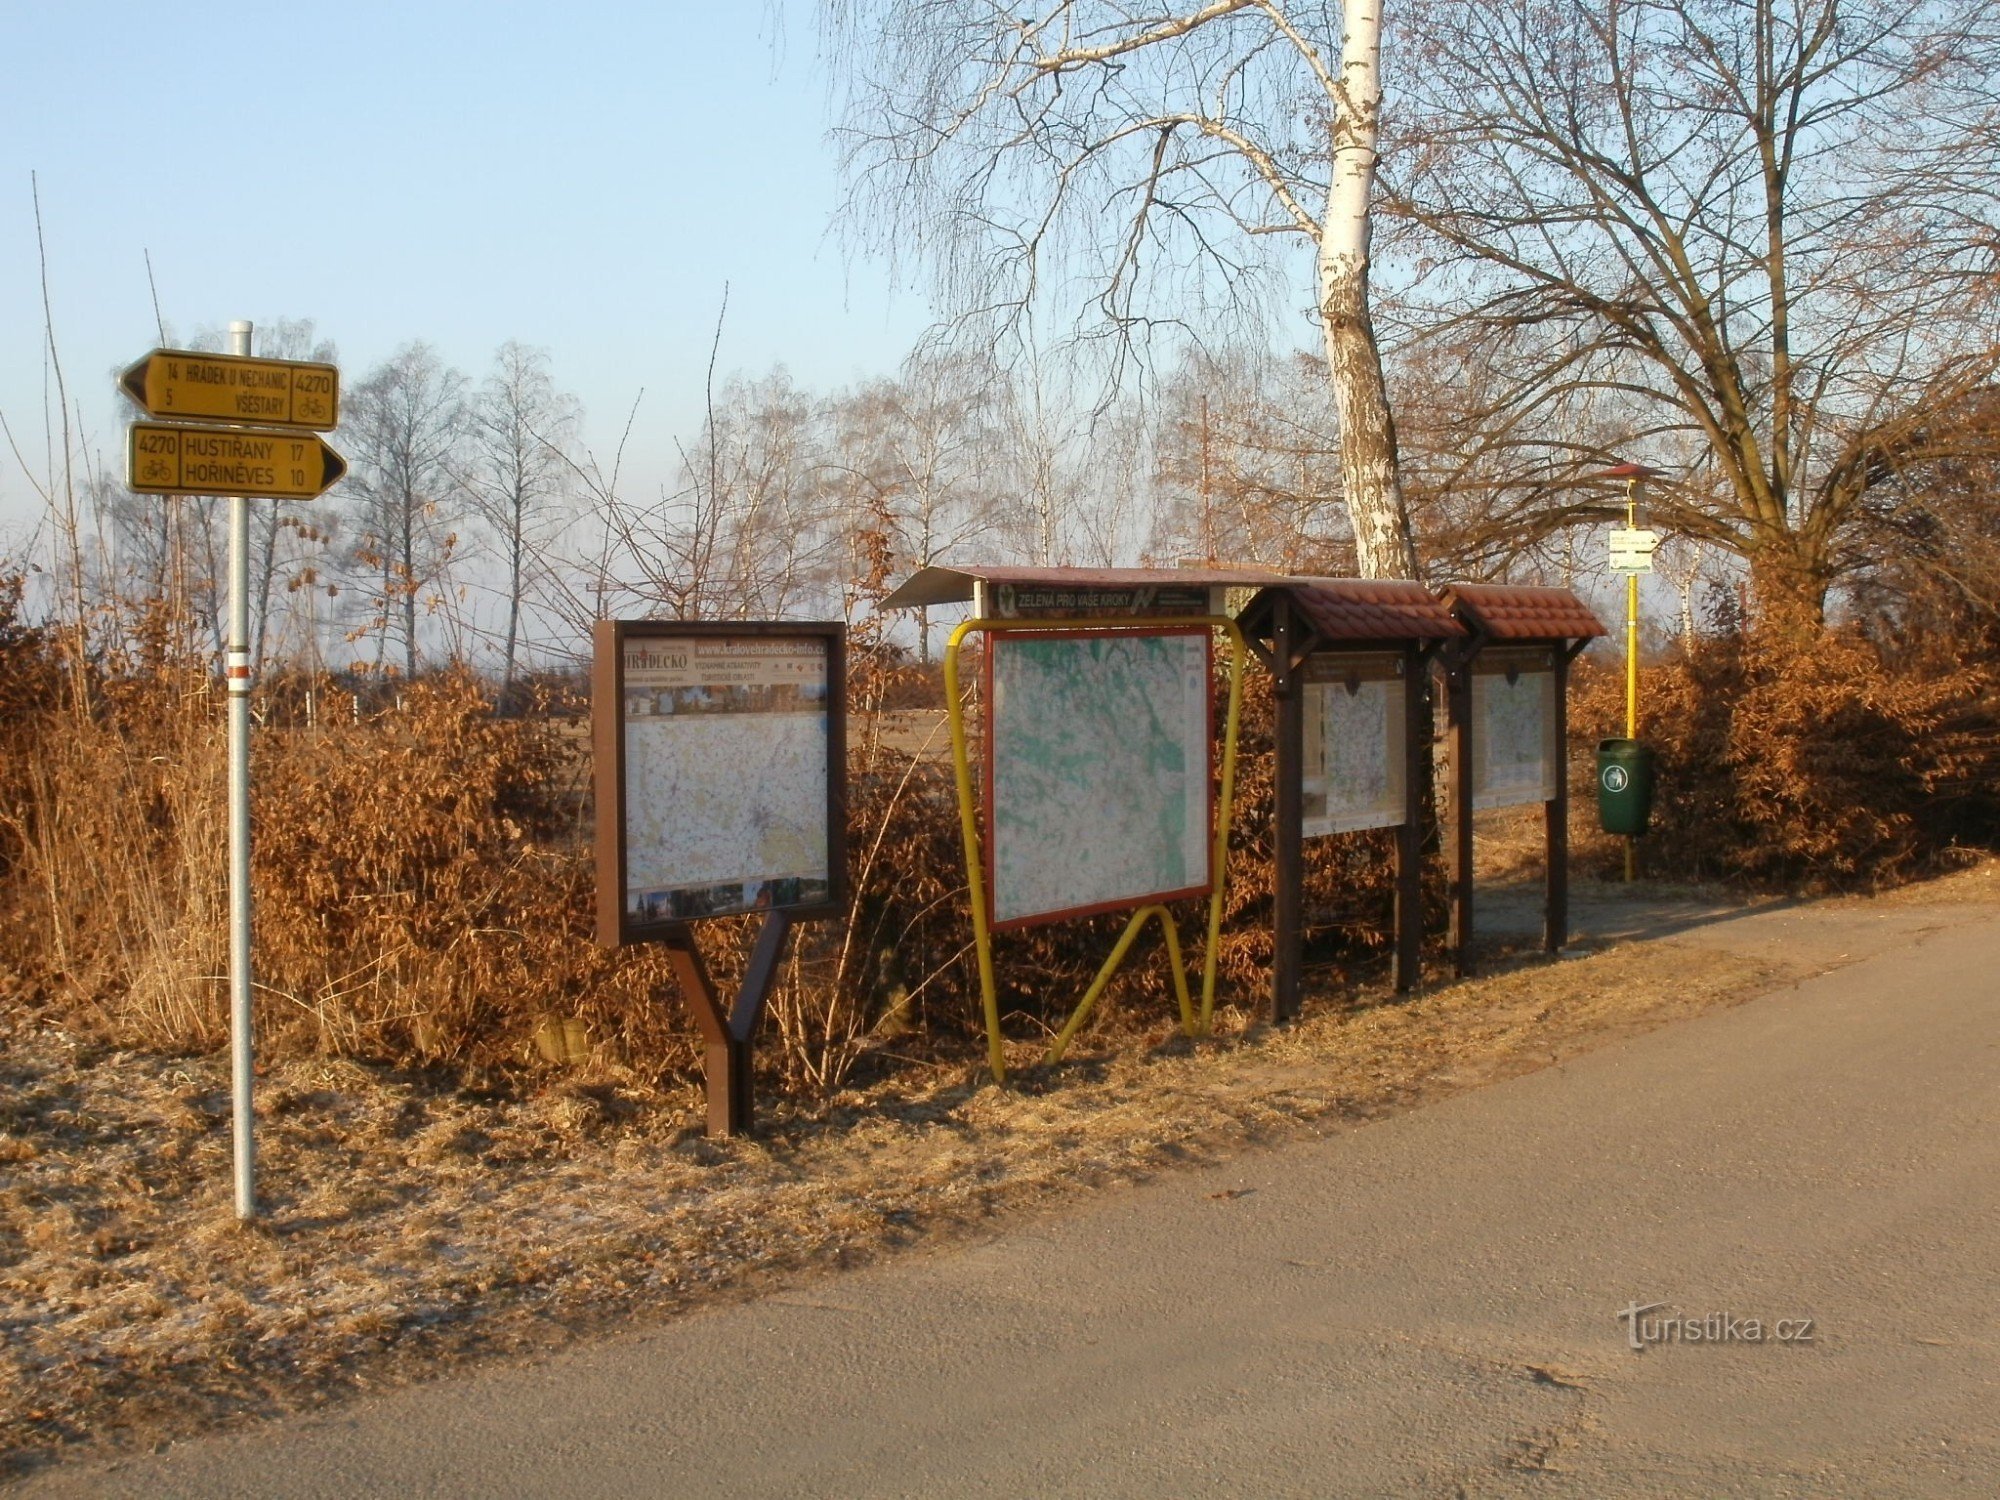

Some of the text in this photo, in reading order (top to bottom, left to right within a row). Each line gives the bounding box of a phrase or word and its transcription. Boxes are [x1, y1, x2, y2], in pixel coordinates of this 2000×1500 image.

[167, 362, 287, 391] 14 HRÁDEK U NECHANIC
[295, 375, 330, 394] 4270
[166, 388, 284, 414] 5 VŠESTARY
[139, 435, 176, 455] 4270
[185, 434, 304, 462] HUSTIŘANY 17
[185, 463, 304, 487] HOŘINĚVES 10
[1056, 591, 1076, 607] PRO
[1100, 592, 1131, 607] KROKY
